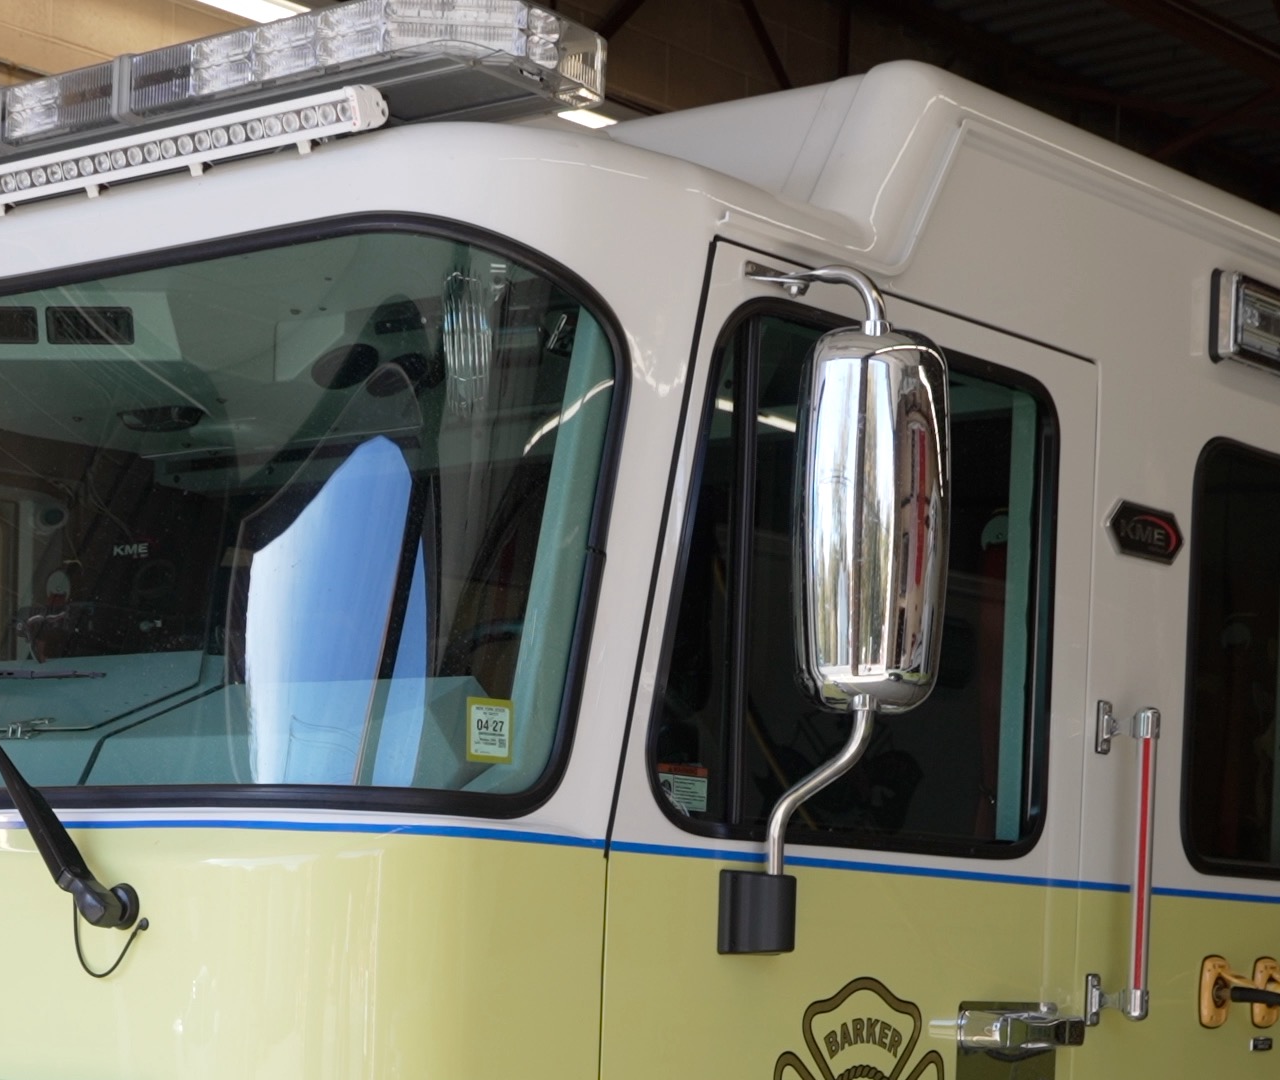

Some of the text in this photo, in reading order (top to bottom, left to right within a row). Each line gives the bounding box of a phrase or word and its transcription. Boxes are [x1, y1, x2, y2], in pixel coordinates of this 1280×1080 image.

[1120, 519, 1166, 546] KME
[113, 543, 149, 556] KME
[477, 719, 505, 732] 04 27
[824, 1017, 902, 1060] BARKER
